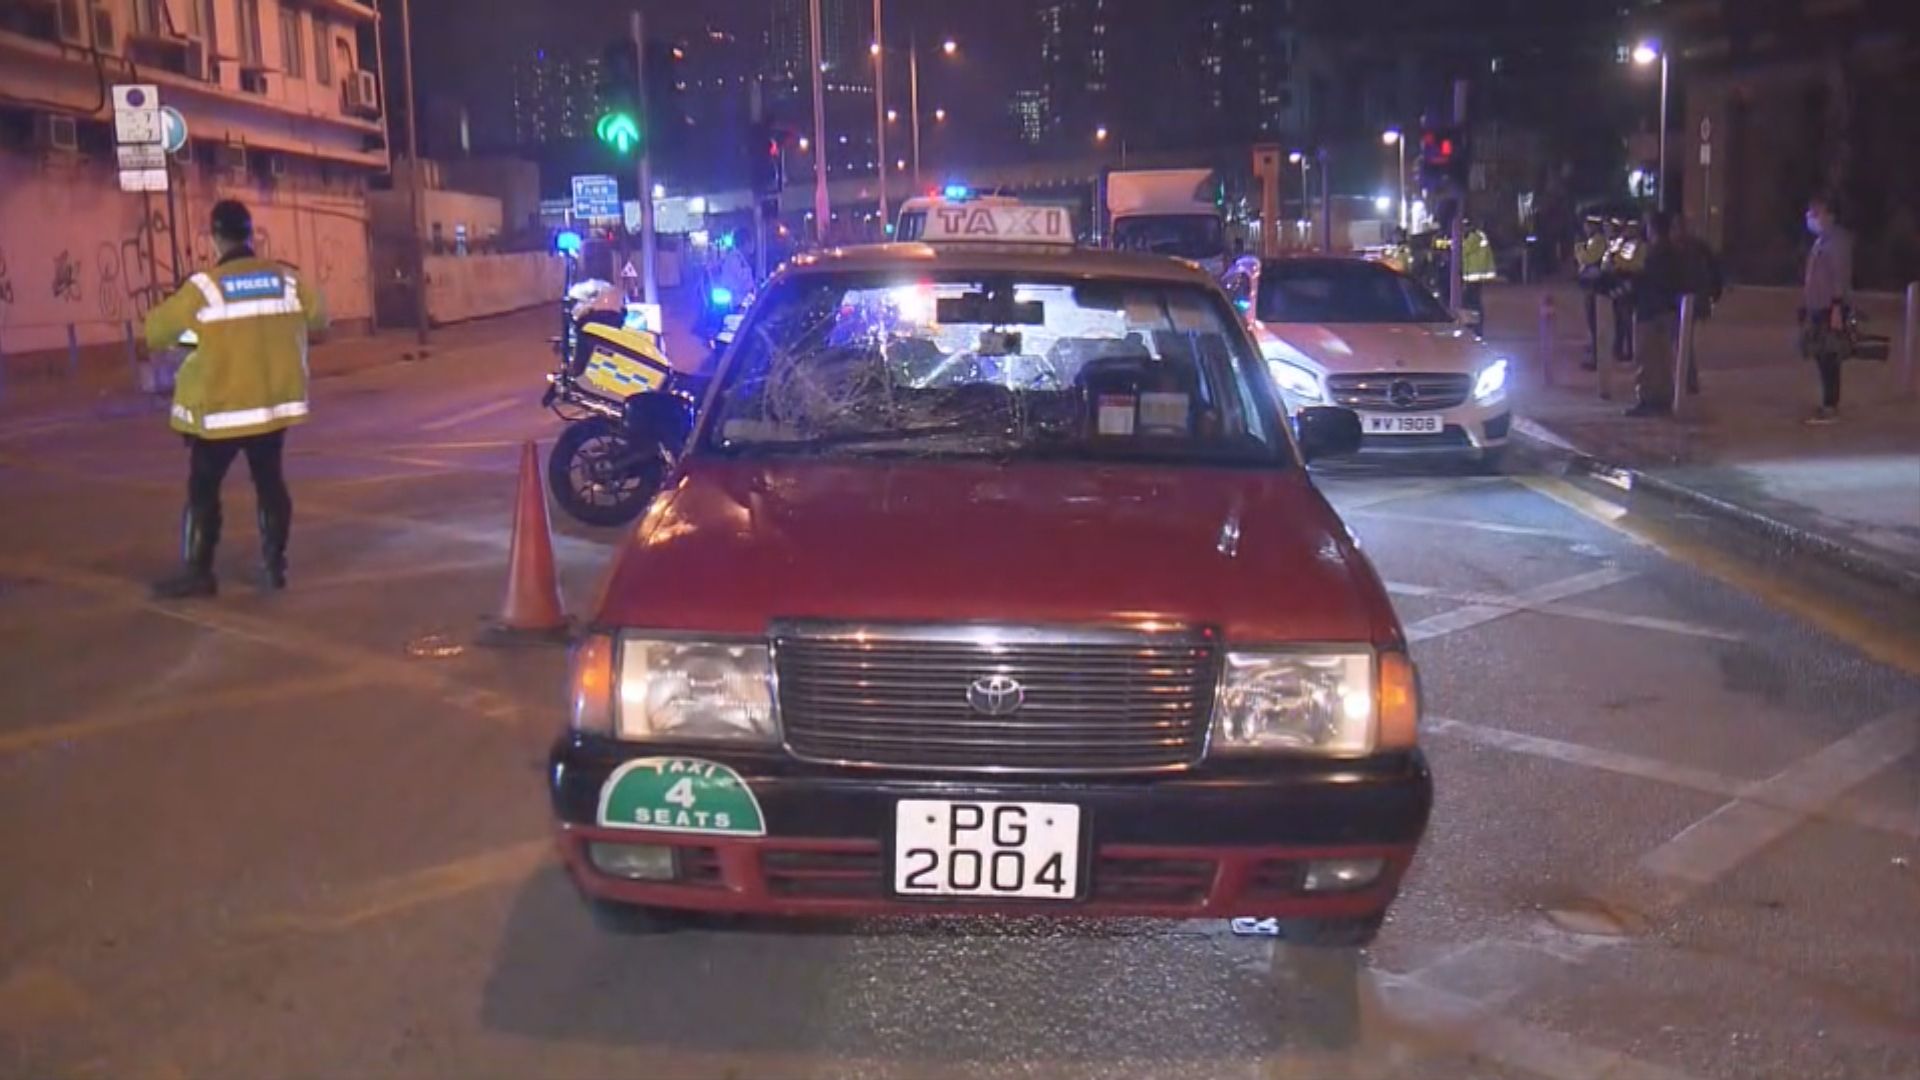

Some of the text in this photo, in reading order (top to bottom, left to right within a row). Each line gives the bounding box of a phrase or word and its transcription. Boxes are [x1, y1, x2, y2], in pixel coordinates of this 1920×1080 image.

[938, 208, 1062, 236] TAXI
[235, 277, 270, 291] POLICE
[1398, 417, 1436, 431] 1908
[654, 759, 717, 779] TAXI
[664, 776, 696, 809] 4
[634, 807, 731, 828] SEATS
[949, 803, 1028, 848] PG
[904, 847, 1067, 894] 2004
